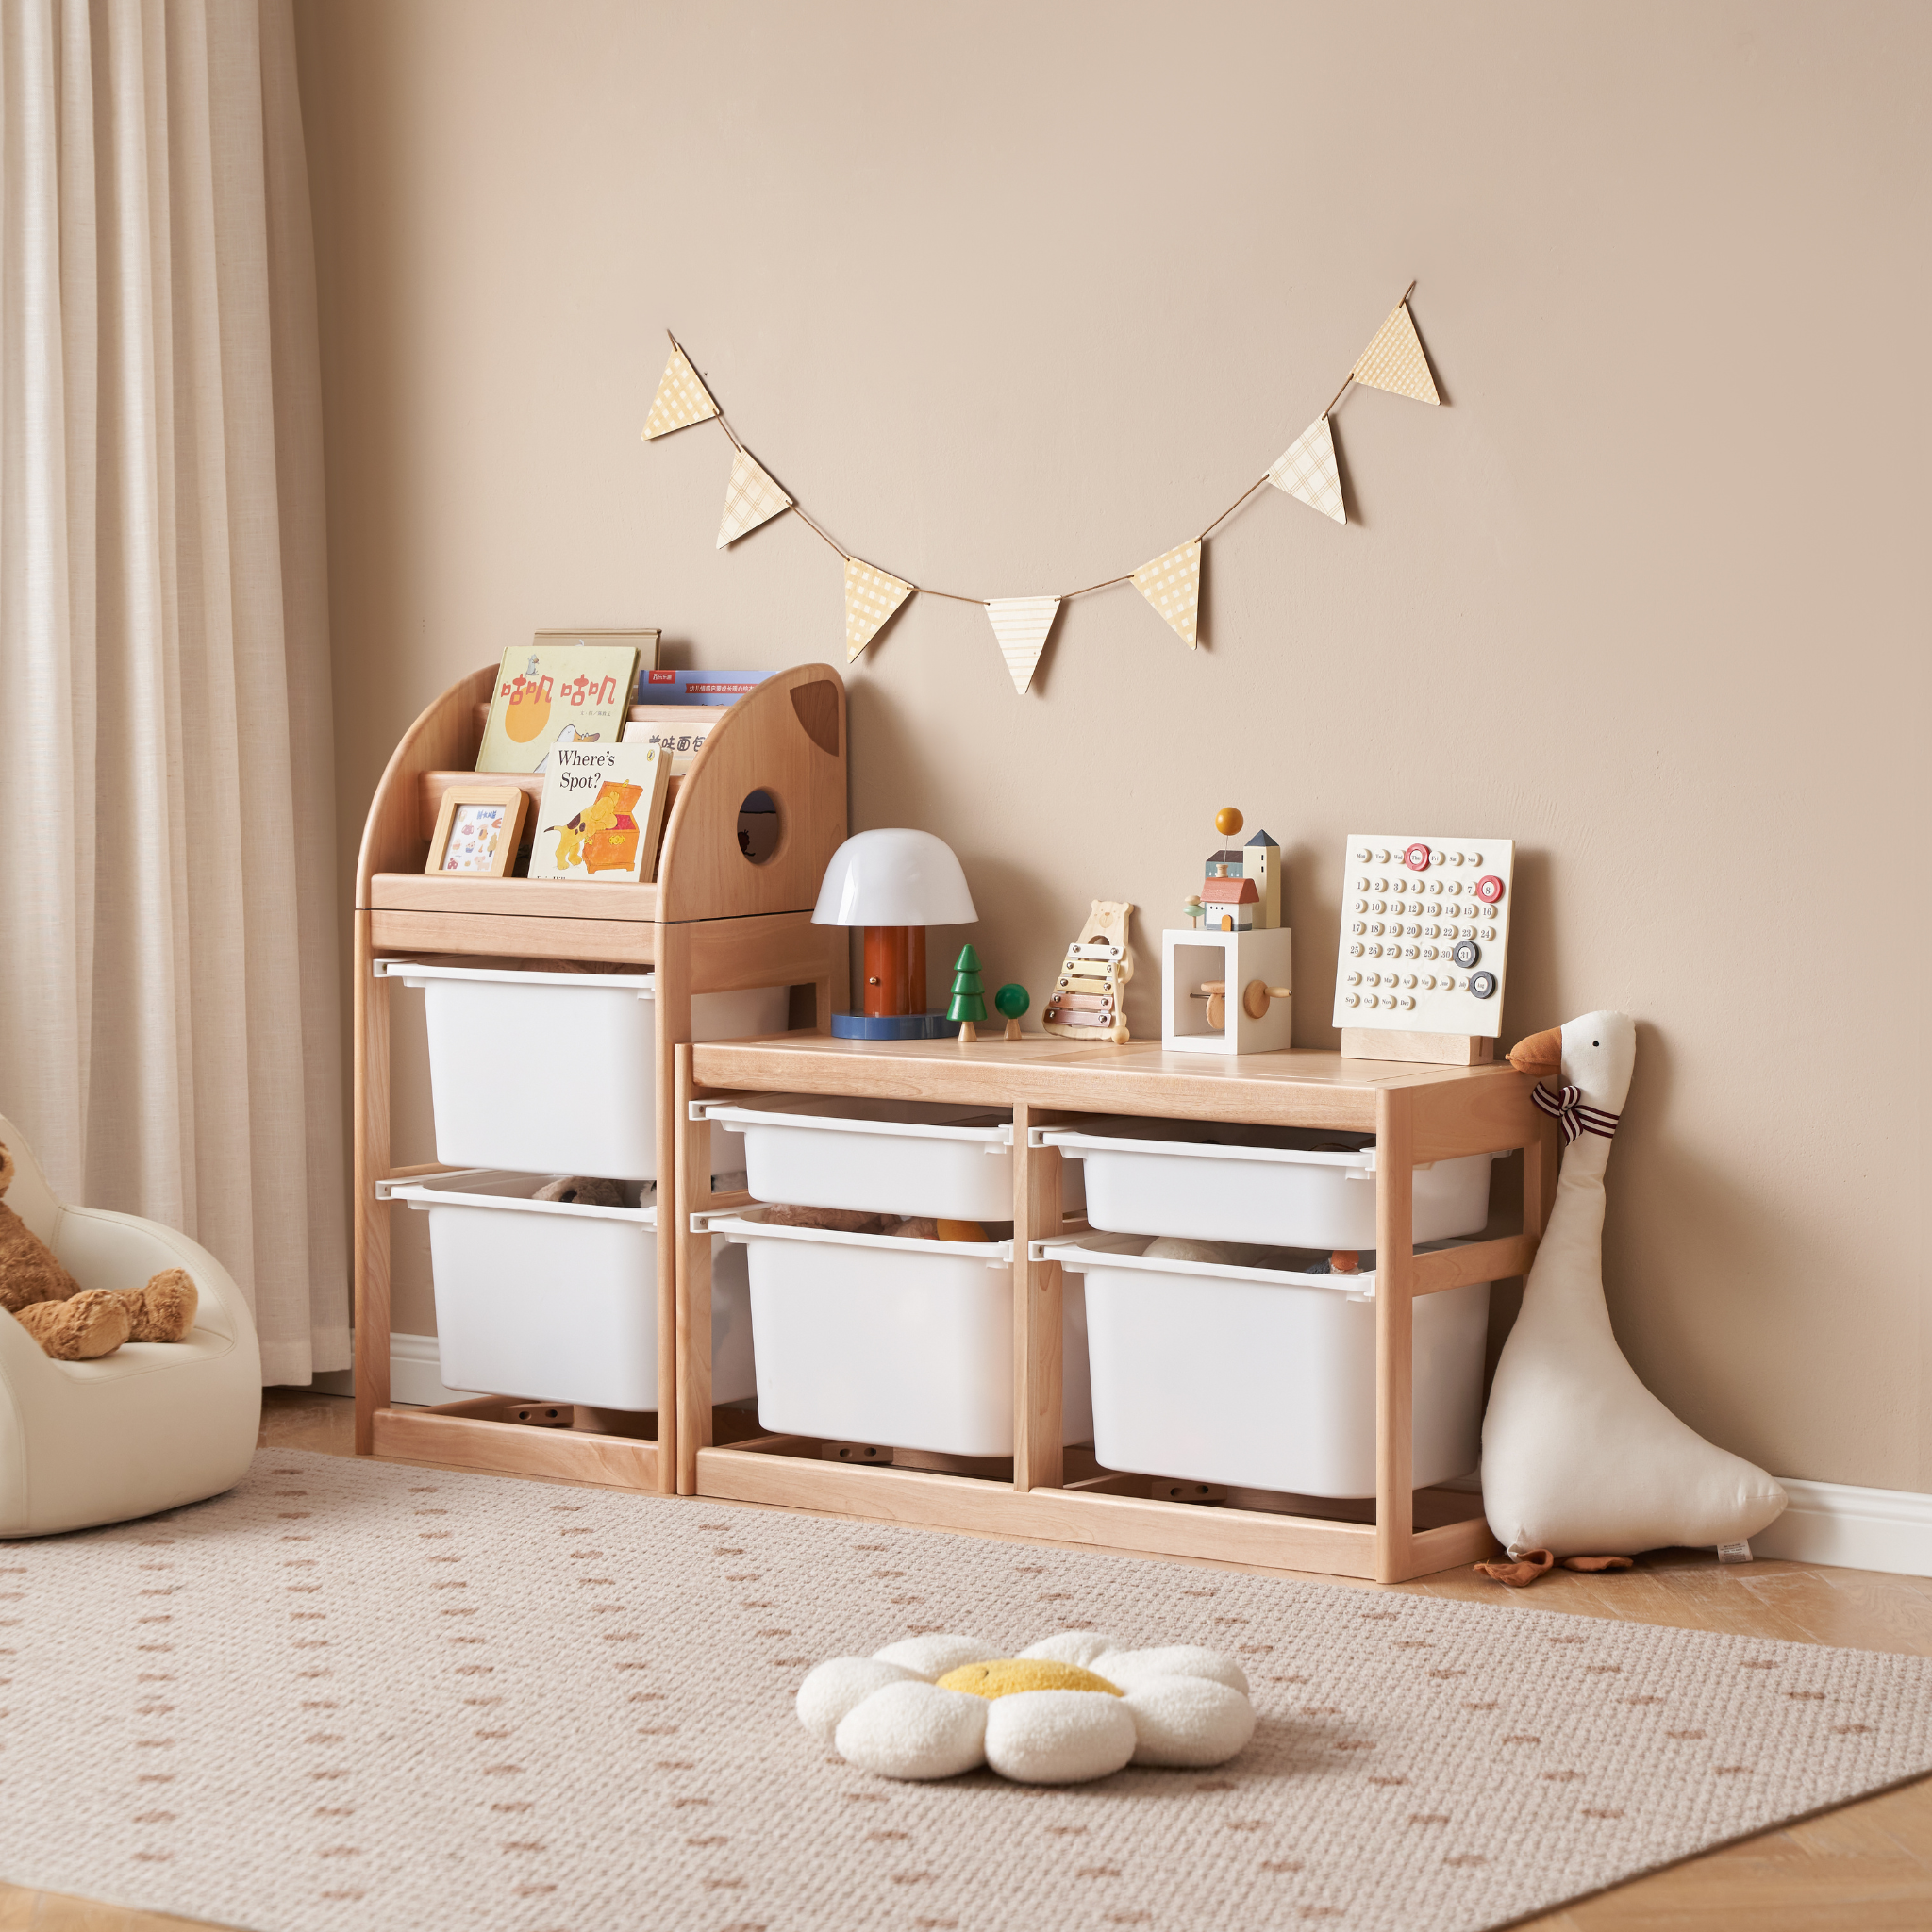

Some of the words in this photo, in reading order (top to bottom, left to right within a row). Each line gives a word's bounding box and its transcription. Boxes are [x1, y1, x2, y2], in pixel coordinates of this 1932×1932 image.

[500, 674, 554, 706] 咕叽
[560, 674, 617, 707] 咕叽
[558, 749, 615, 766] Where's
[559, 772, 601, 791] Spot?
[1372, 903, 1380, 911] 10
[1391, 904, 1398, 912] 11
[1445, 906, 1454, 914] 14
[1463, 907, 1472, 915] 15
[1483, 908, 1491, 916] 16
[1371, 924, 1379, 933] 18
[1389, 925, 1397, 934] 19
[1407, 926, 1416, 935] 20
[1424, 927, 1434, 936] 21
[1443, 928, 1453, 937] 22
[1461, 929, 1472, 938] 23
[1405, 948, 1414, 957] 28
[1423, 949, 1433, 958] 29
[1441, 950, 1451, 958] 30
[1460, 951, 1469, 959] 31
